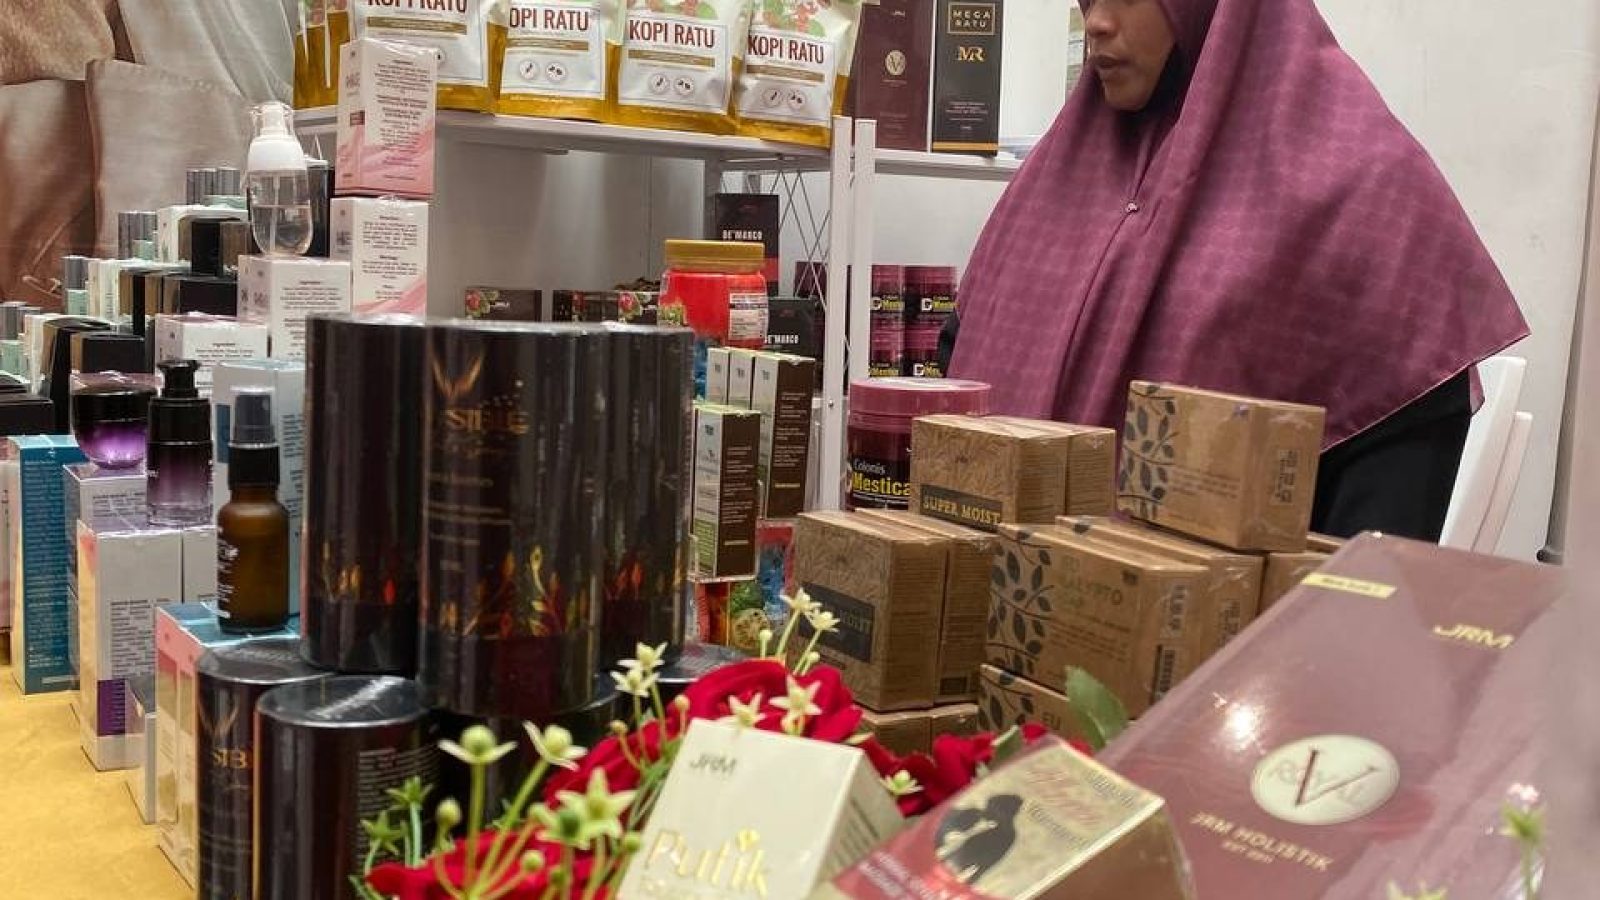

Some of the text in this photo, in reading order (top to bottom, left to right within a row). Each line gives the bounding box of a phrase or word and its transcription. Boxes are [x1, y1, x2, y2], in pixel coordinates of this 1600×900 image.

[509, 8, 589, 31] OPI RATU
[953, 10, 991, 19] MEGA
[954, 20, 986, 28] RATU
[629, 20, 715, 49] KOPI RATU
[748, 35, 825, 64] KOPI RATU
[922, 495, 1001, 525] SUPER MOIST
